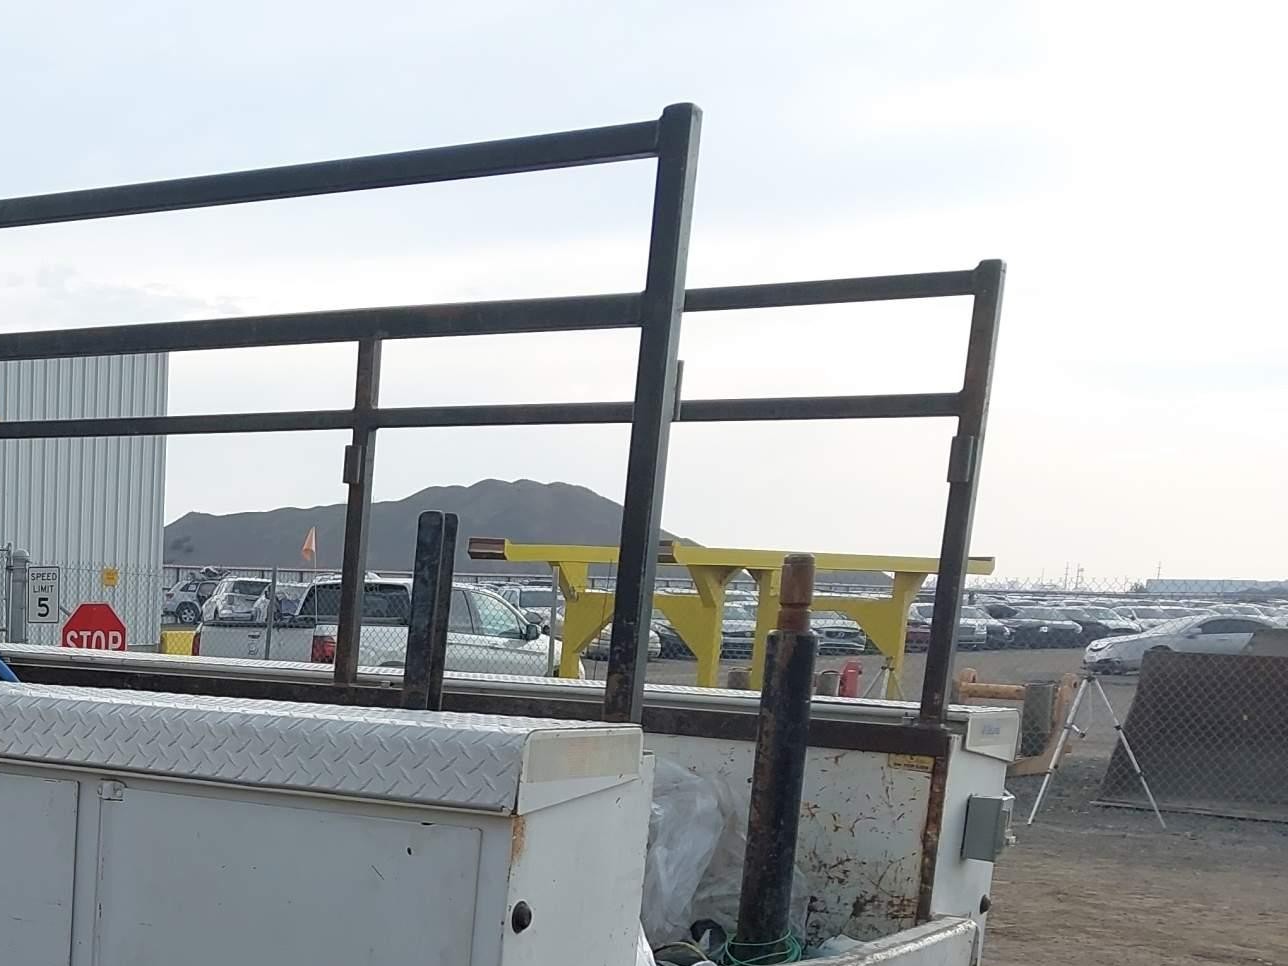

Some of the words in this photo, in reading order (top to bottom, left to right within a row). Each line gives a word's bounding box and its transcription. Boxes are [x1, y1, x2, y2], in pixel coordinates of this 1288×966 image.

[31, 573, 57, 581] SPEED
[33, 585, 54, 593] LIMIT
[37, 597, 50, 618] 5
[66, 630, 122, 650] STOP
